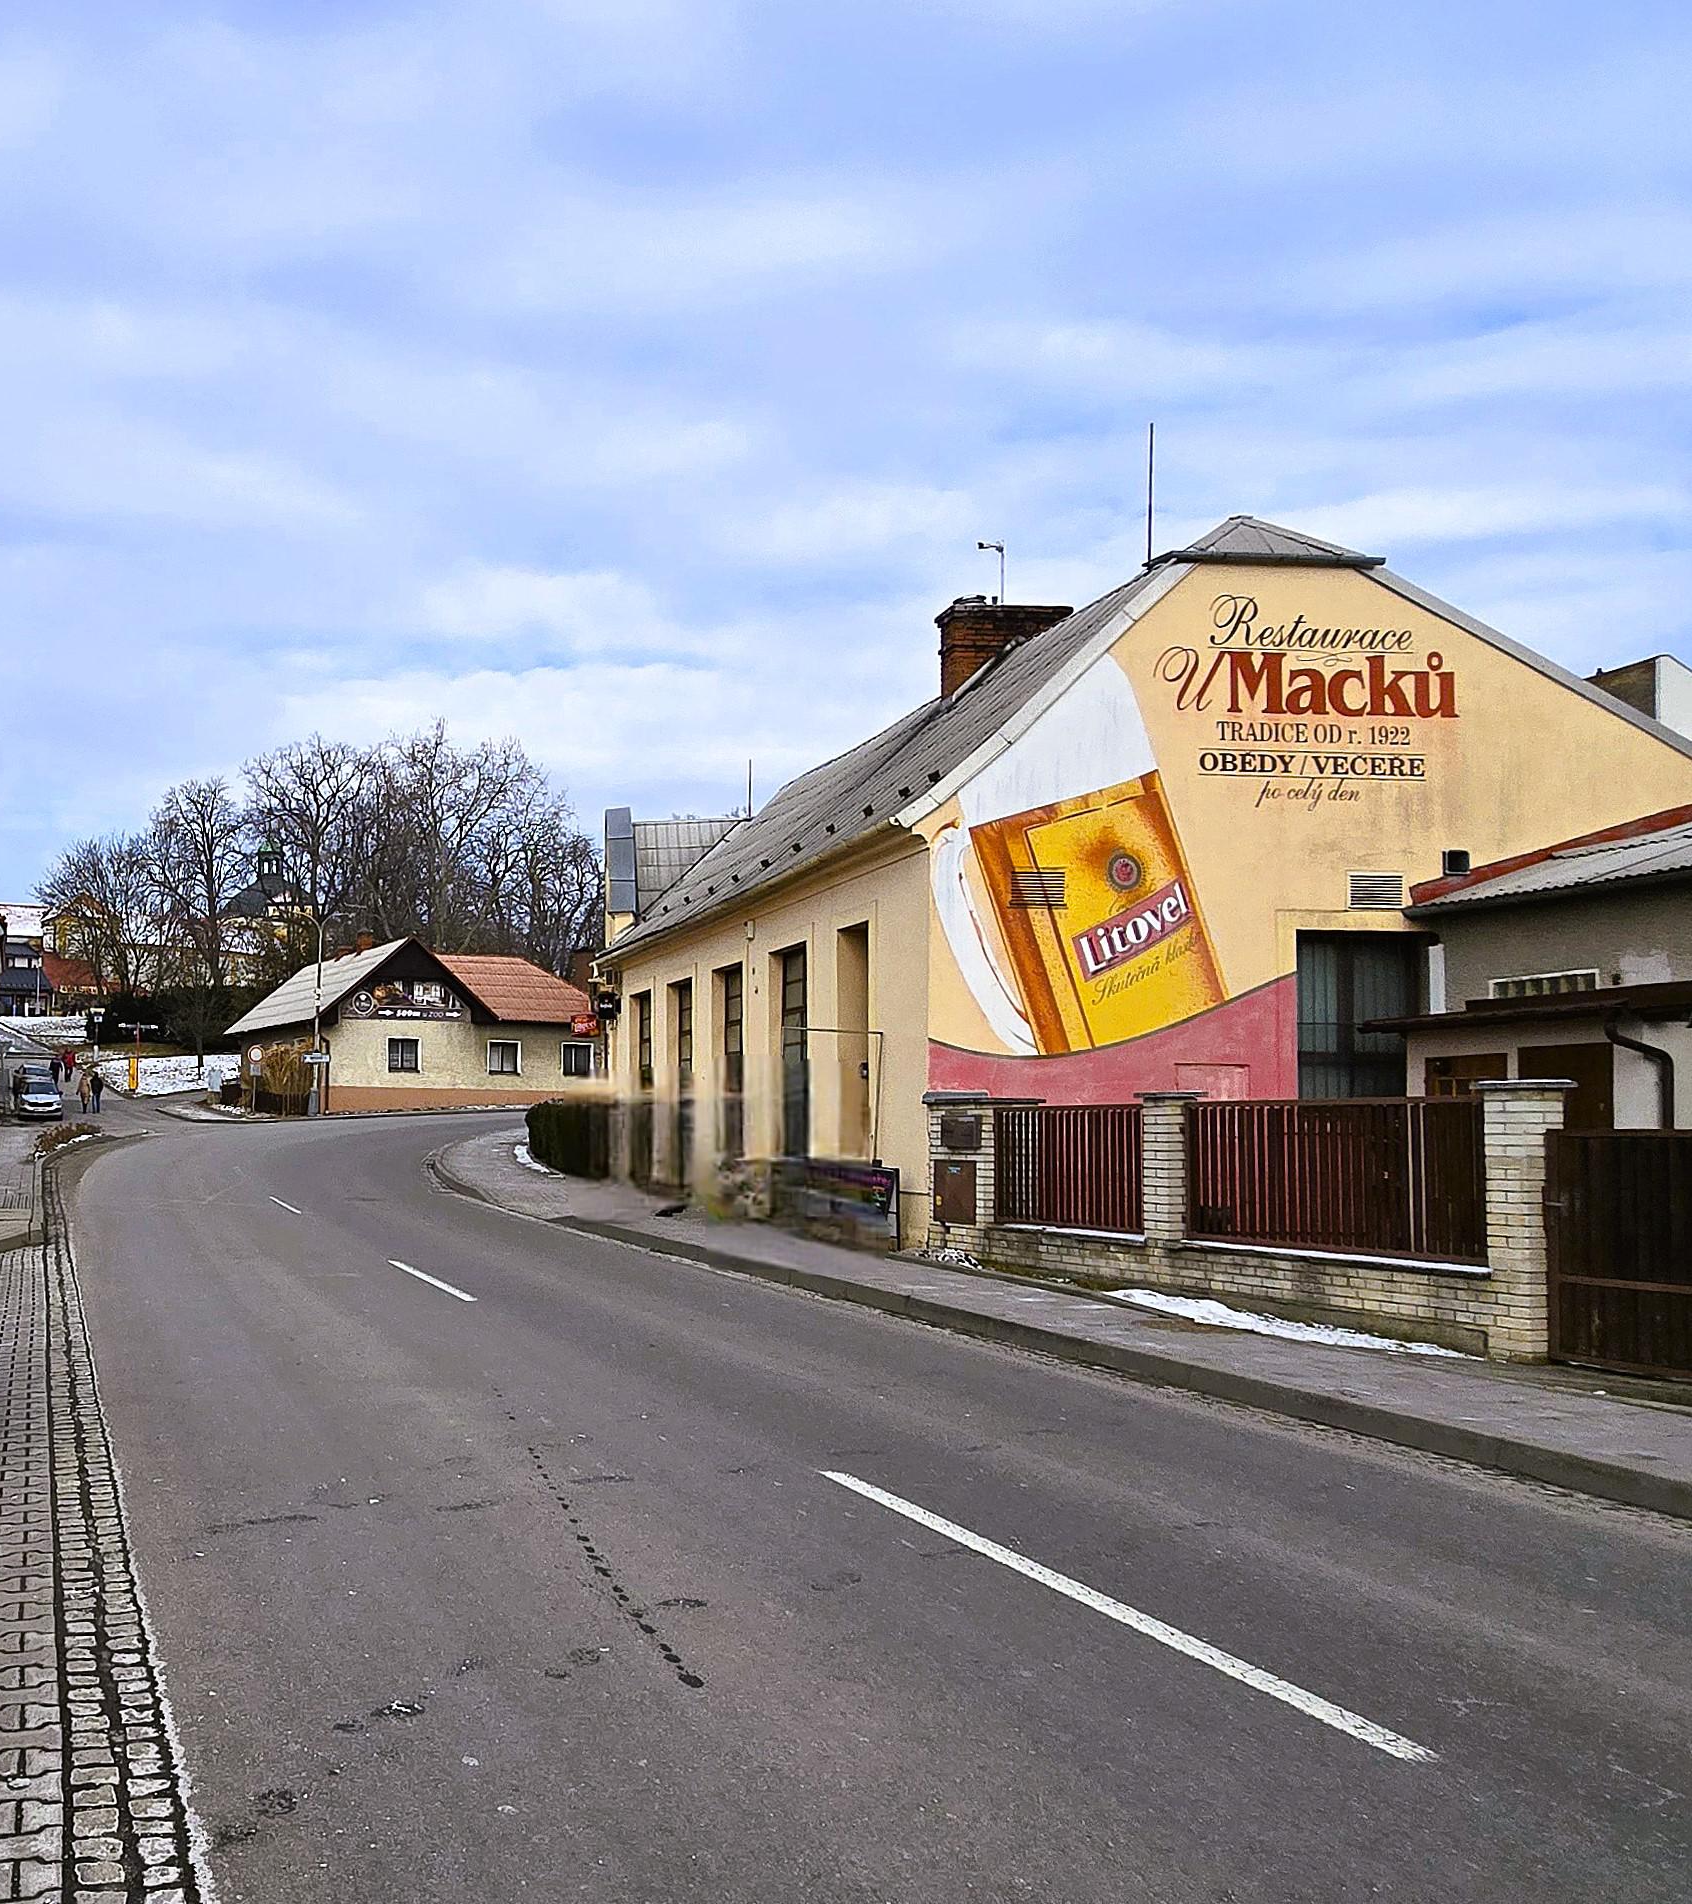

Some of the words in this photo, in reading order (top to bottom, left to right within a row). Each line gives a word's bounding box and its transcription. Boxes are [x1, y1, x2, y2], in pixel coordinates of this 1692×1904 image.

[1209, 594, 1413, 651] Restaurace
[1153, 646, 1225, 711] U
[1223, 651, 1459, 718] Macků
[1215, 720, 1308, 743] TRADICE
[1313, 723, 1342, 744] OD
[1347, 728, 1362, 745] r.
[1368, 725, 1411, 746] 1922
[1311, 754, 1426, 777] VEČEŘE
[1254, 780, 1283, 808] po
[1286, 778, 1323, 811] celý
[1327, 778, 1361, 801] den
[1079, 882, 1190, 975] Litovel
